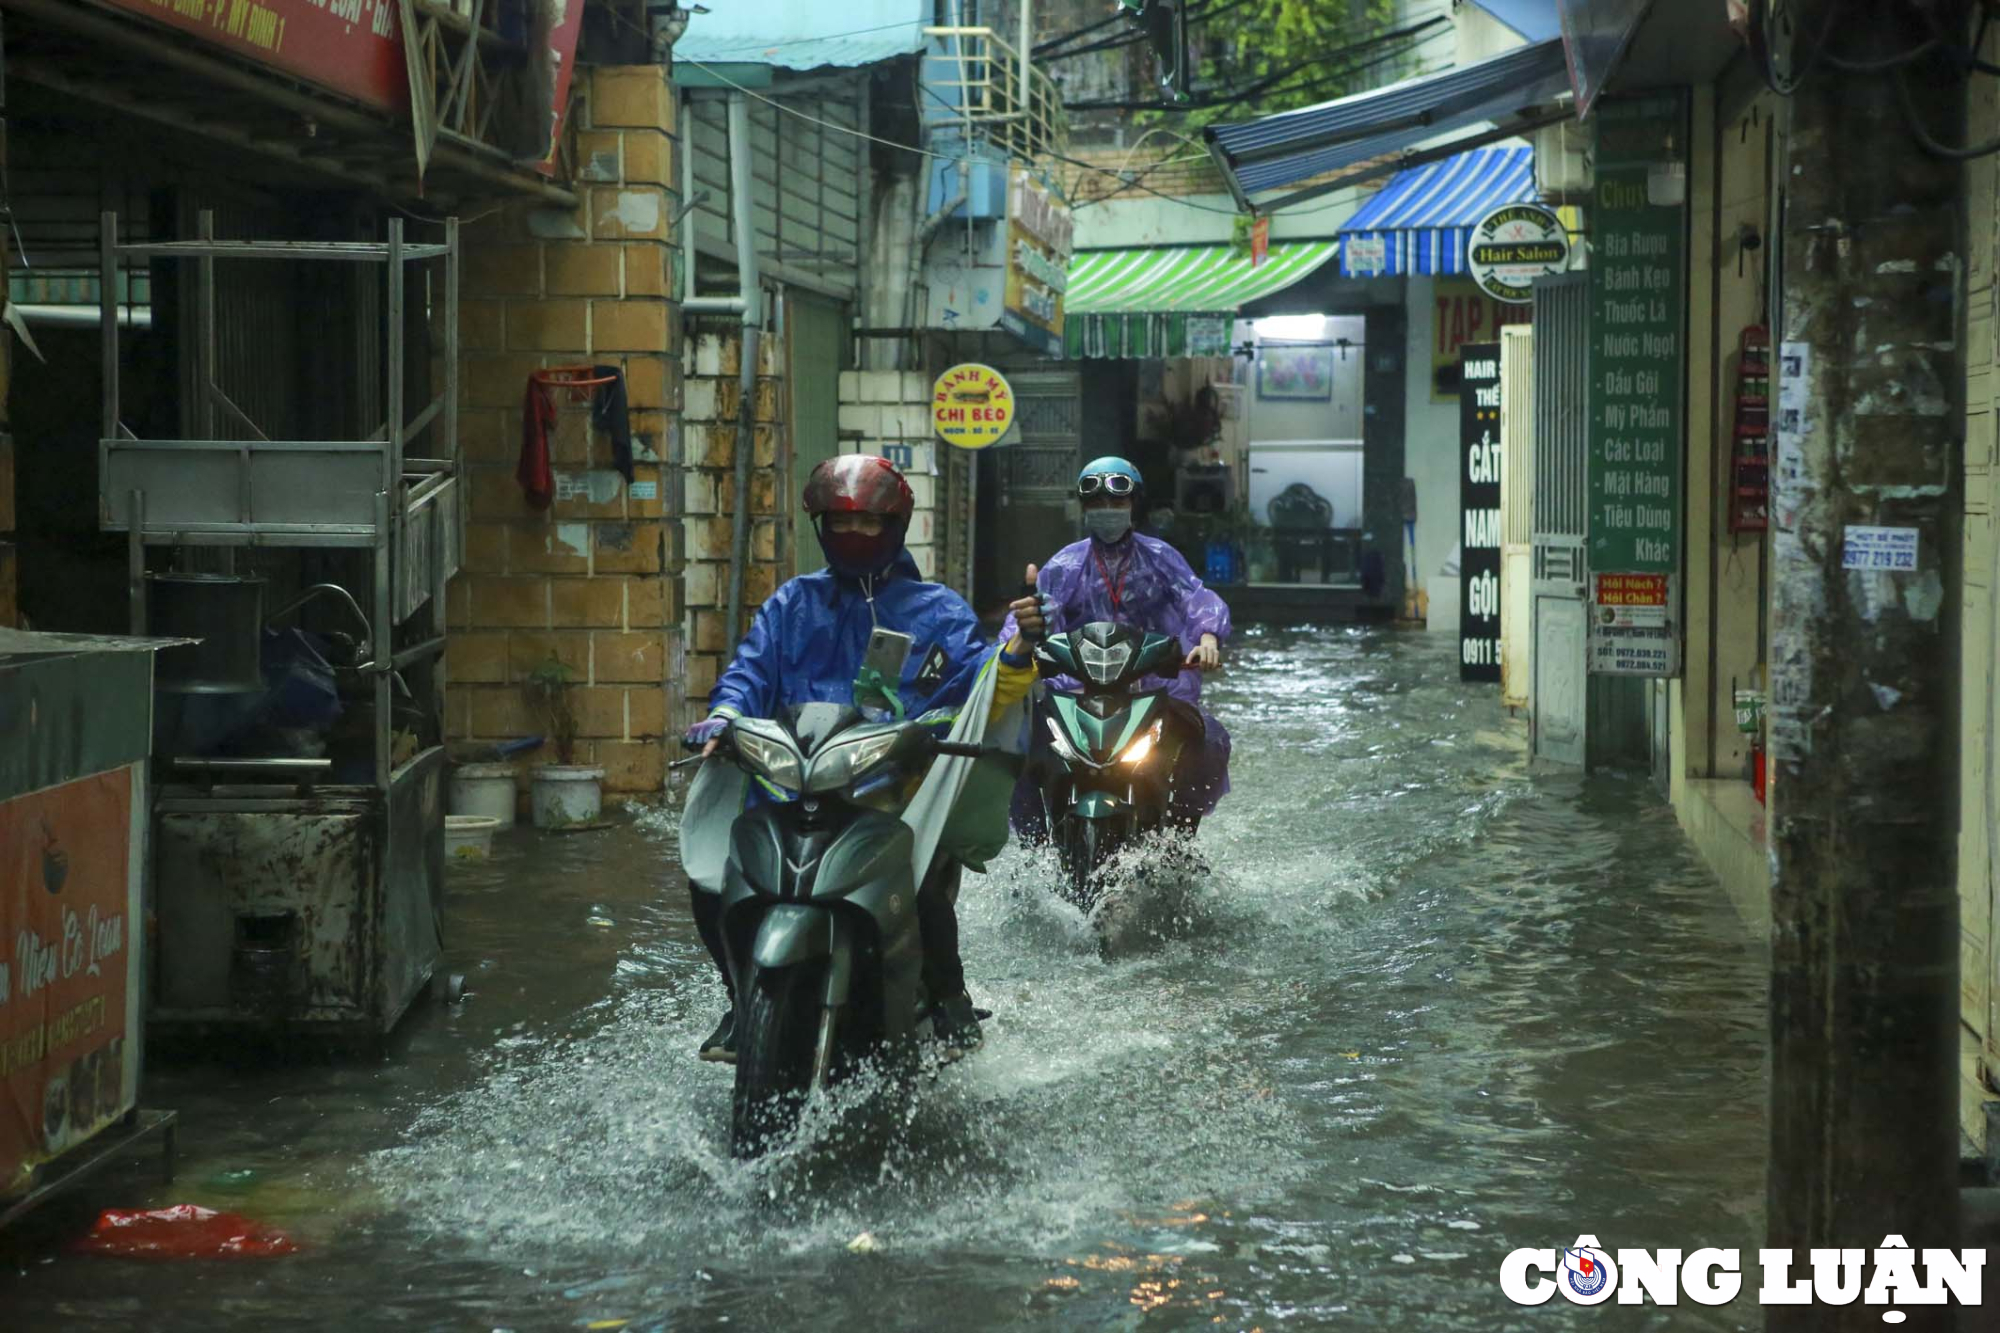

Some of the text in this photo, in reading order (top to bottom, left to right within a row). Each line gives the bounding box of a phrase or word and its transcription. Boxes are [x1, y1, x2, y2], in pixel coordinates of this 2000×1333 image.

[1601, 180, 1646, 211] Chuy
[1480, 246, 1558, 262] Hair Salon
[1605, 232, 1628, 257] Bia
[1604, 265, 1671, 293] Bánh Kẹo
[1604, 295, 1646, 324] Thuốc
[1604, 331, 1675, 361] Nước Ngọt
[1465, 360, 1496, 379] HAIR
[1475, 383, 1500, 407] THẾ
[1636, 369, 1659, 399] Gội
[936, 408, 965, 424] CHỊ
[1604, 404, 1626, 432] Mỹ
[1604, 437, 1665, 467] Các Loại
[1604, 470, 1670, 500] Mặt Hàng
[1465, 508, 1501, 548] NAM
[1603, 503, 1671, 532] Tiêu Dùng
[1635, 537, 1670, 562] Khác
[1469, 569, 1498, 622] GỘI
[1463, 638, 1490, 664] 0911
